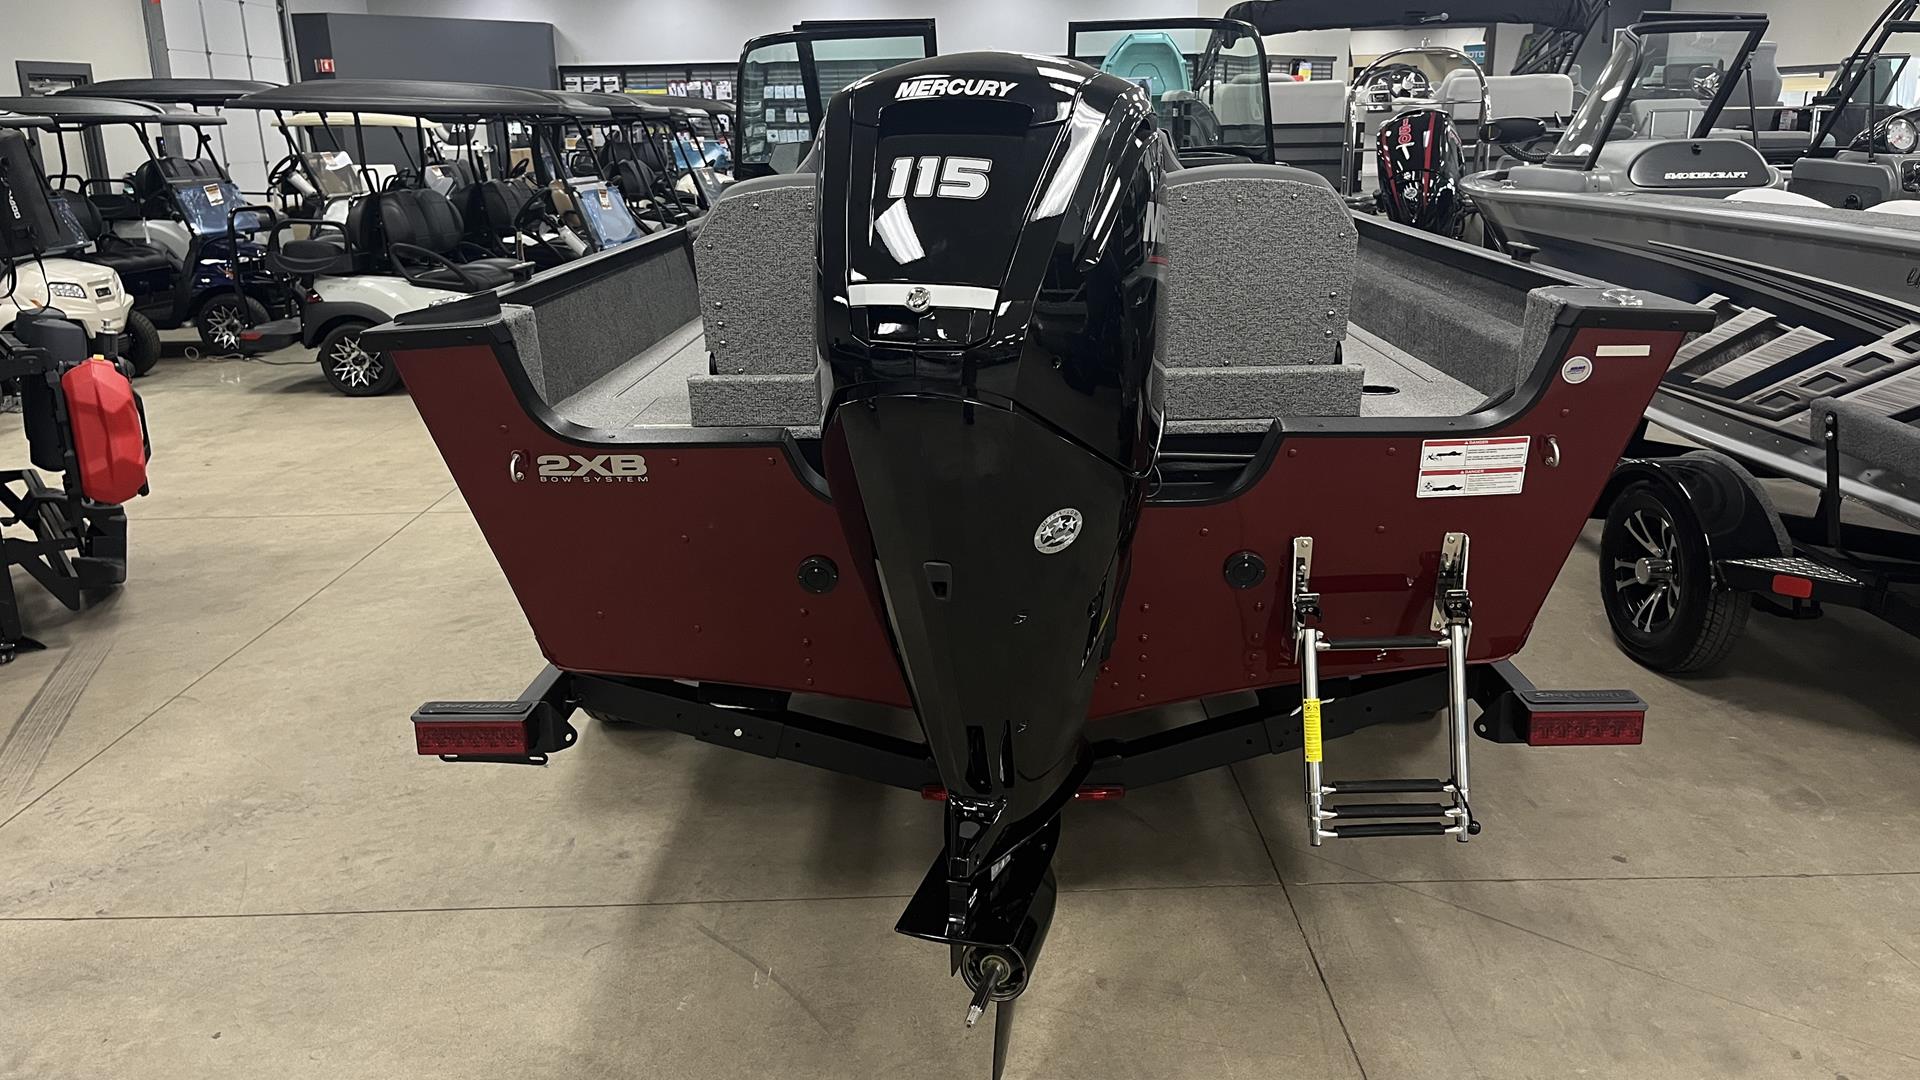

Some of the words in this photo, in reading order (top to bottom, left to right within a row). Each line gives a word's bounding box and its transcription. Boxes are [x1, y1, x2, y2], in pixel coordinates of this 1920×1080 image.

[894, 79, 1018, 99] MERCURY
[887, 155, 993, 200] 115
[537, 454, 648, 477] 2XB
